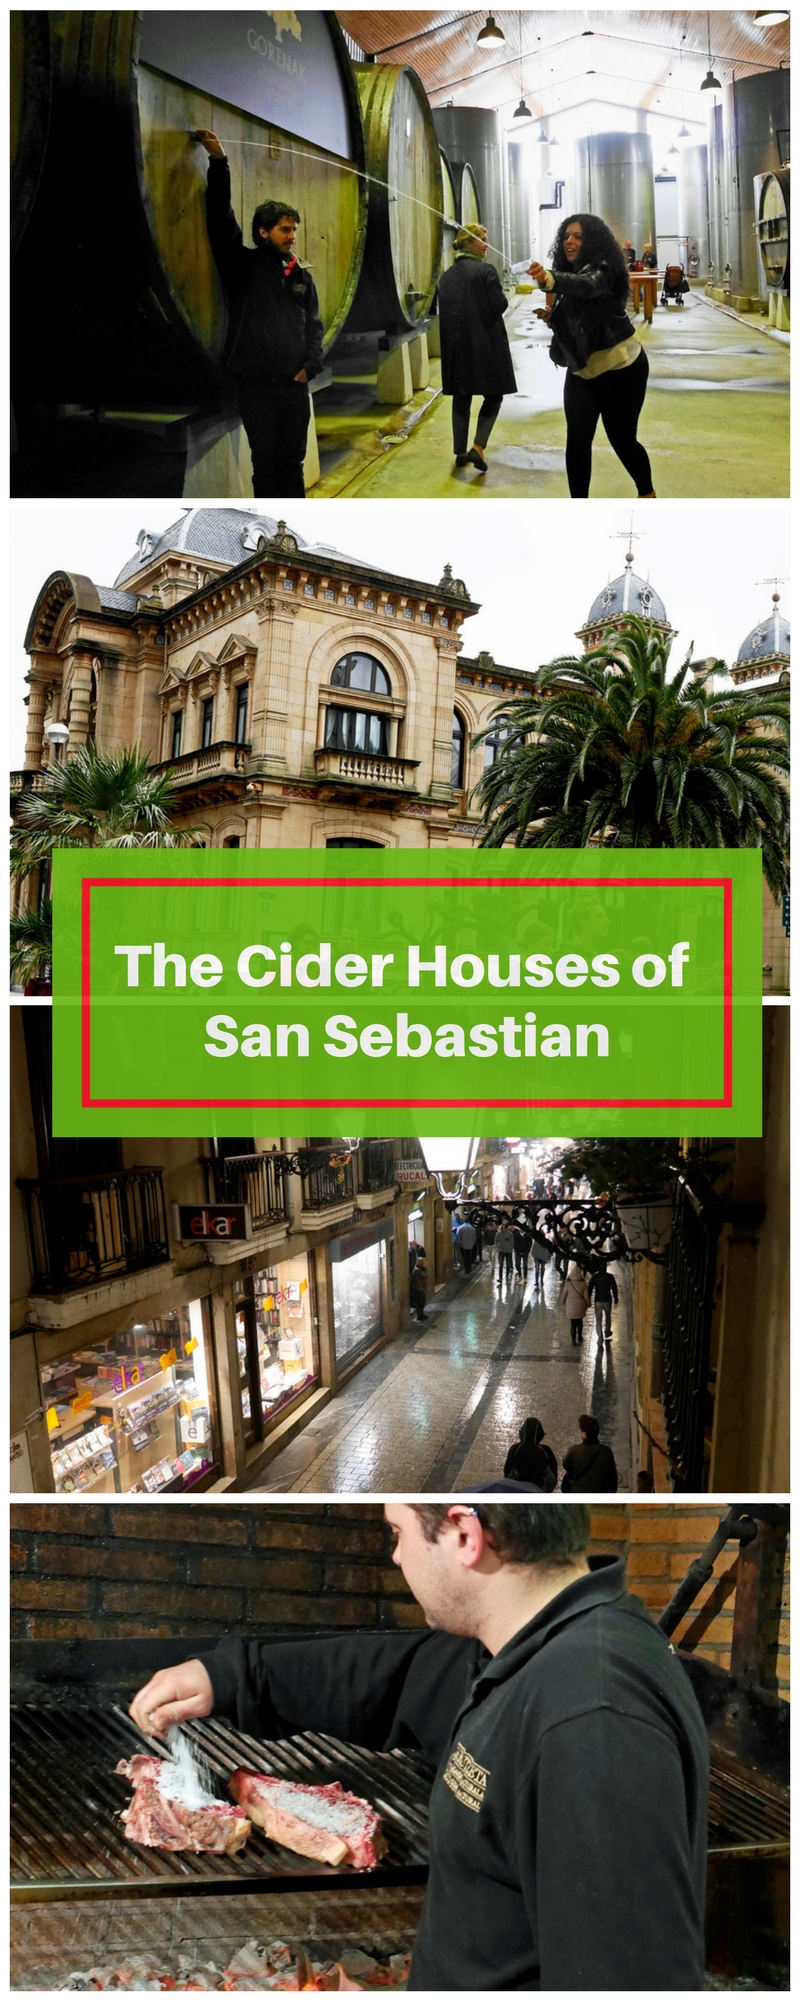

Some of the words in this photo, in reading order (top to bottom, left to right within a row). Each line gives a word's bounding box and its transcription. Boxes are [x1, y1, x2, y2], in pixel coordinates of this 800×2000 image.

[246, 28, 306, 84] GORENAK
[190, 1210, 237, 1236] elkar
[113, 1362, 145, 1394] elkar
